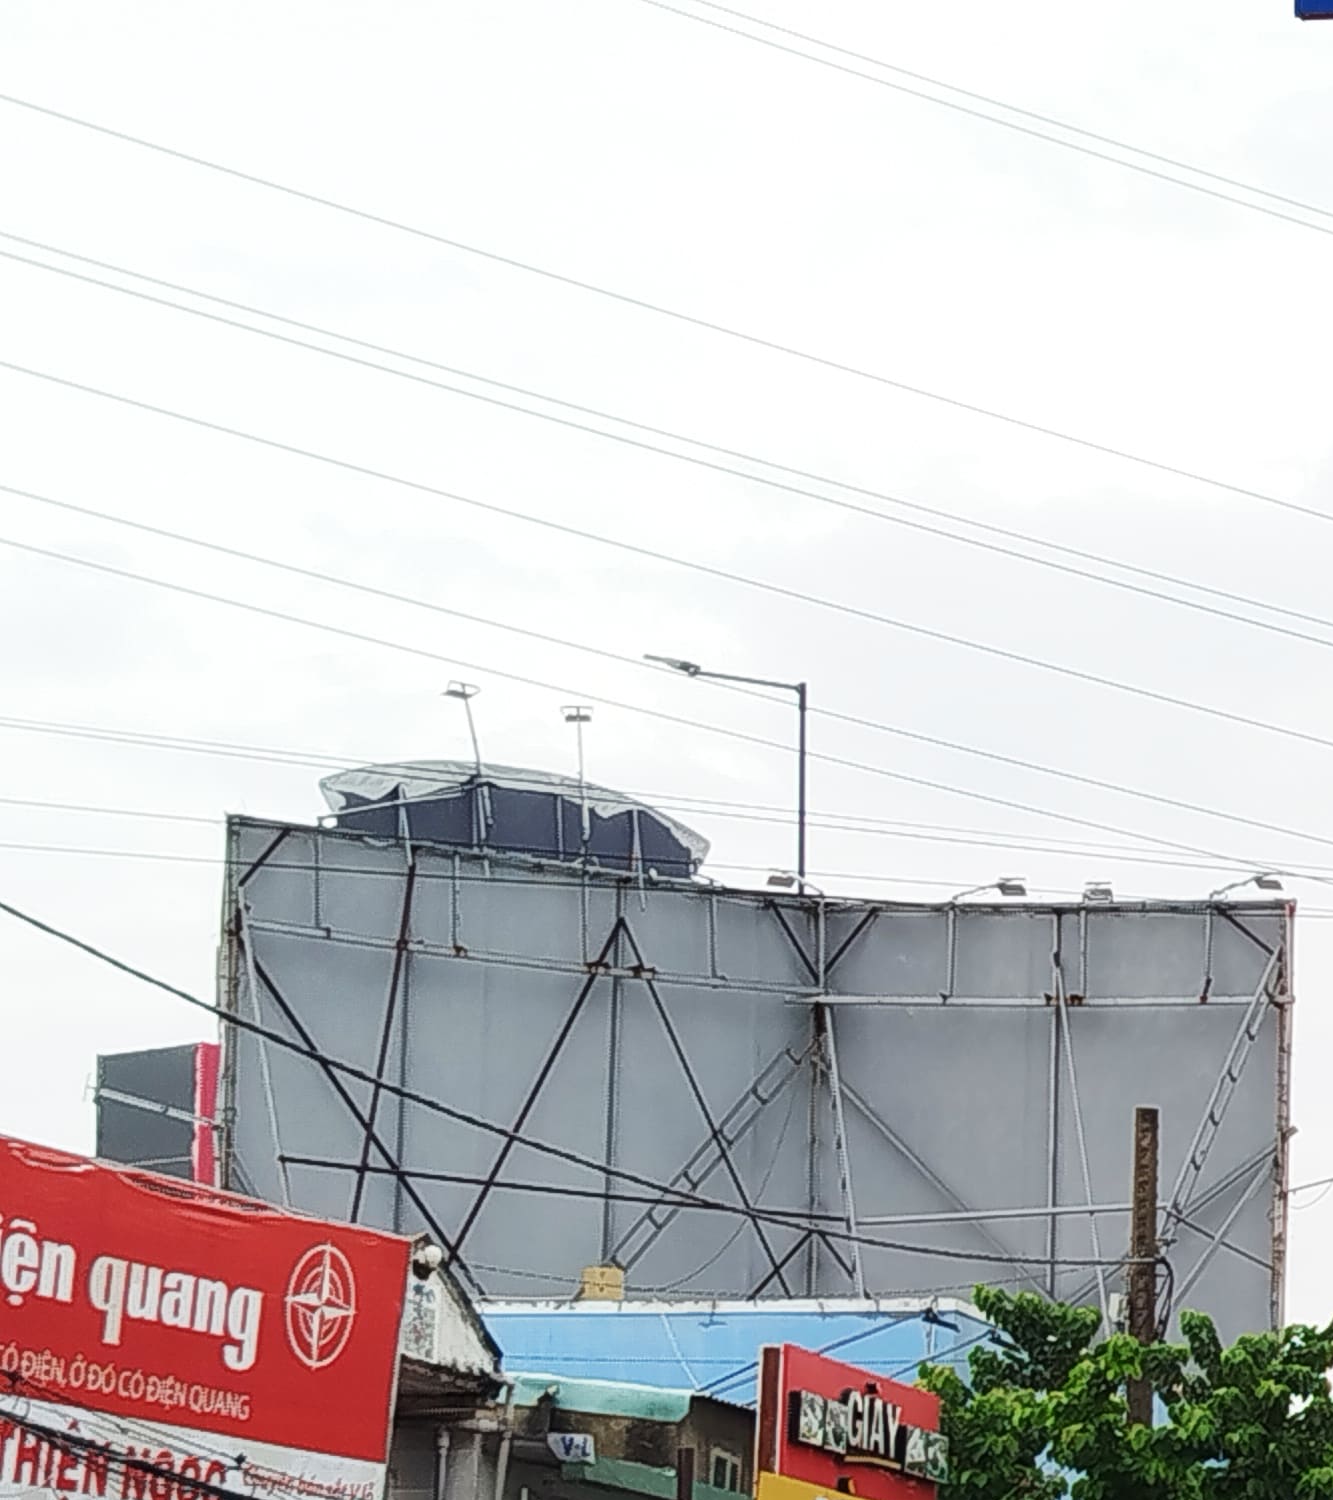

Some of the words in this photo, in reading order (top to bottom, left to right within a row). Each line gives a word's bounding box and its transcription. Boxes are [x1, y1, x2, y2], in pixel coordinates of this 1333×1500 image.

[0, 1212, 75, 1306] ện
[90, 1256, 265, 1372] quang
[0, 1342, 20, 1373] Ó
[189, 1385, 251, 1420] QUANG
